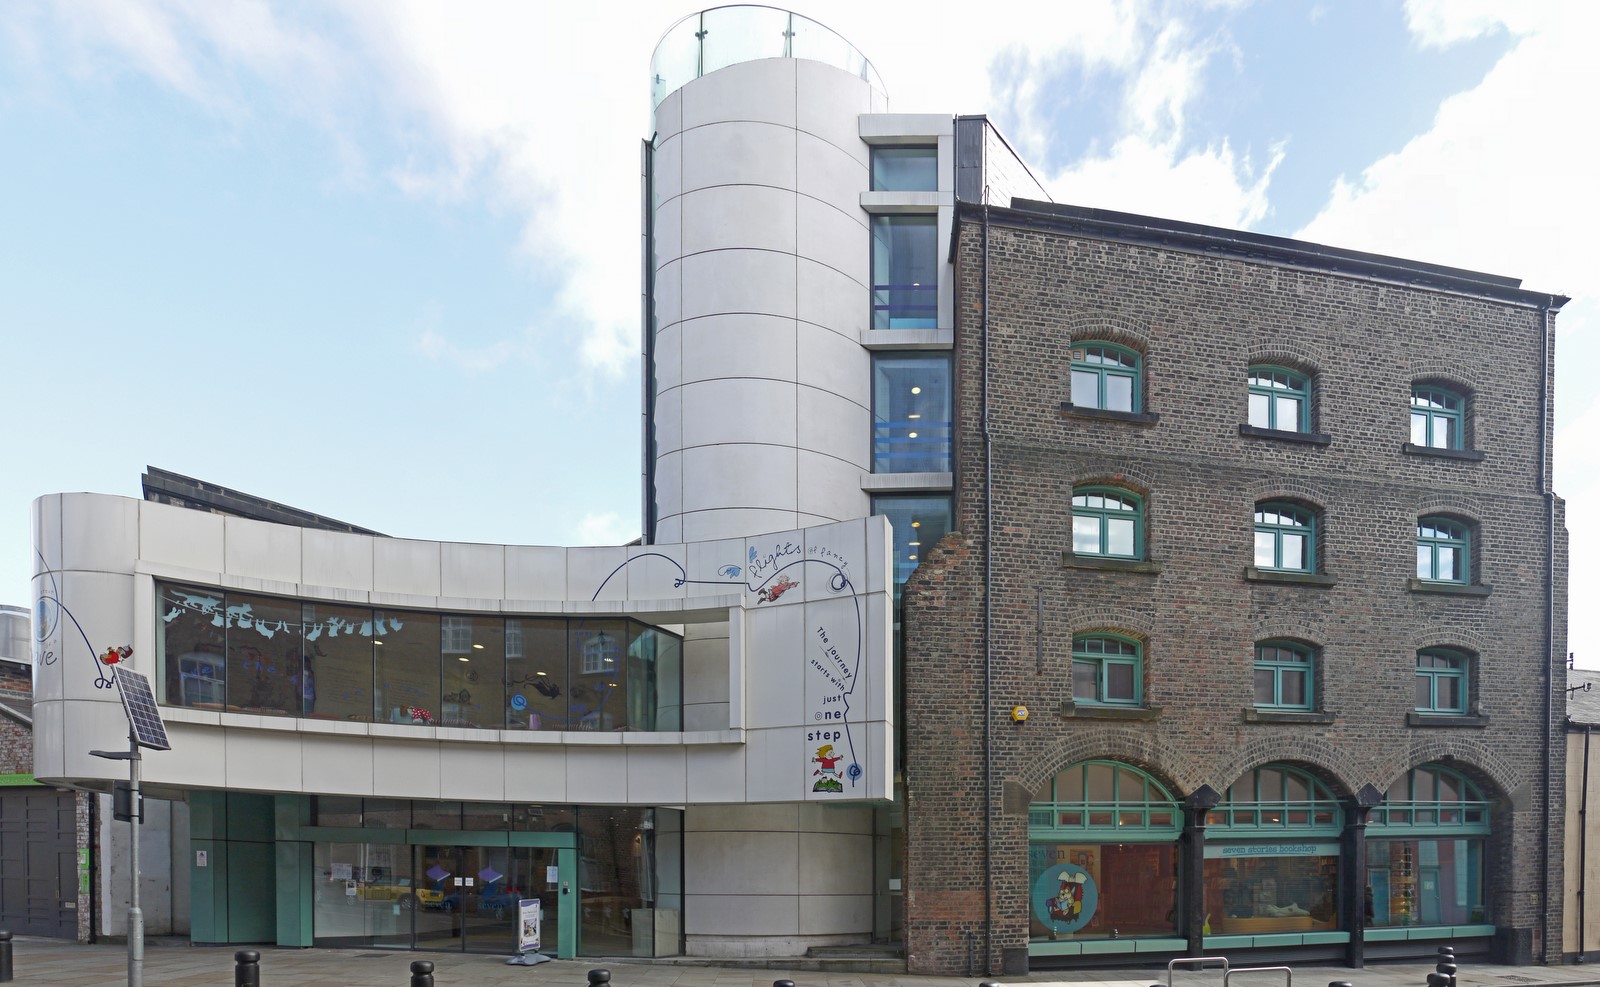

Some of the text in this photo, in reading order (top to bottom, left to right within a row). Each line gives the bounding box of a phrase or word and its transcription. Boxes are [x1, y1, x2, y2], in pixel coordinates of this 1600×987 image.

[749, 542, 802, 578] flights
[820, 547, 849, 570] fancy
[816, 626, 853, 679] The journey
[810, 659, 845, 692] starts with
[822, 694, 842, 705] just
[814, 710, 842, 721] one
[807, 730, 841, 742] step
[1222, 843, 1317, 854] seven stories bookshop
